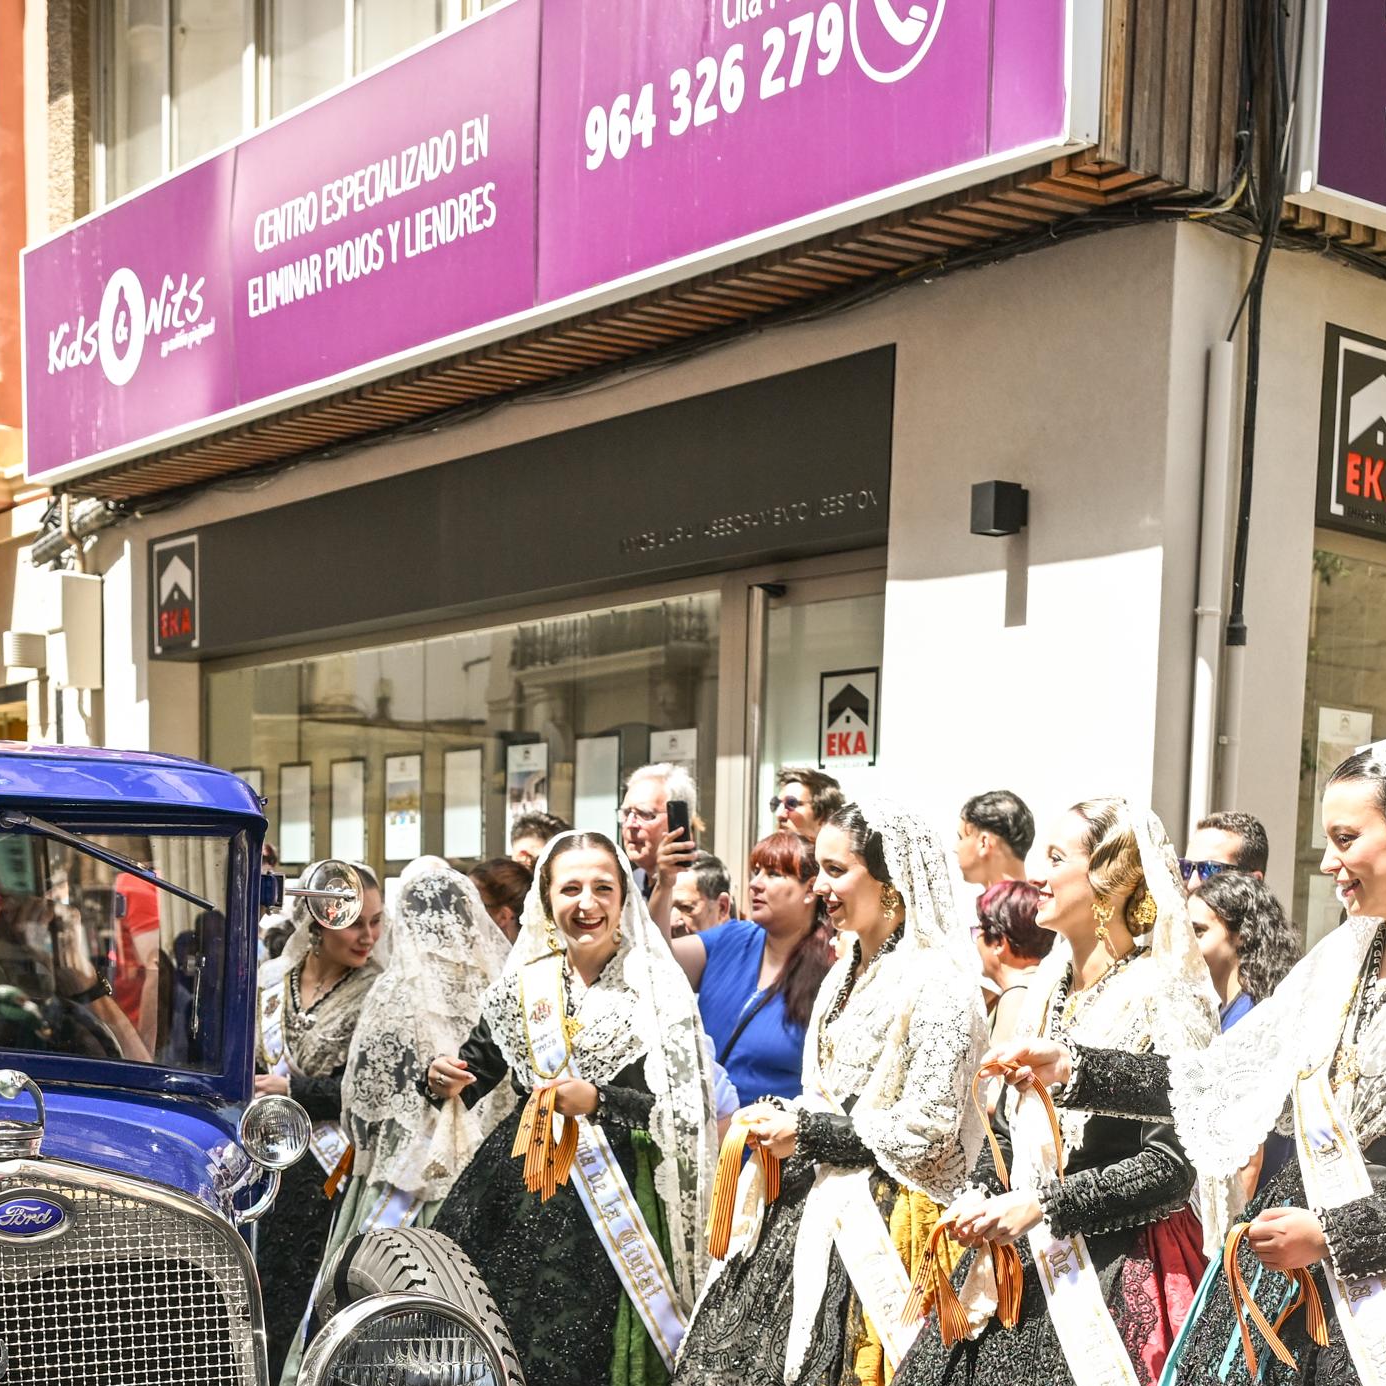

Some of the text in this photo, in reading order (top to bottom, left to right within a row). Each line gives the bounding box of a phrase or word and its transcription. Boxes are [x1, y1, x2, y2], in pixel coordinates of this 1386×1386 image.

[585, 2, 844, 171] 964 326 279
[254, 114, 489, 253] CENTRO ESPECIALIZADO EN
[248, 182, 497, 318] ELIMINAR PIOJOS Y LIENDRES
[47, 316, 99, 375] Kids
[145, 273, 206, 336] Nits
[160, 607, 192, 639] EKA
[827, 731, 868, 757] EKA
[0, 1205, 52, 1226] Ford
